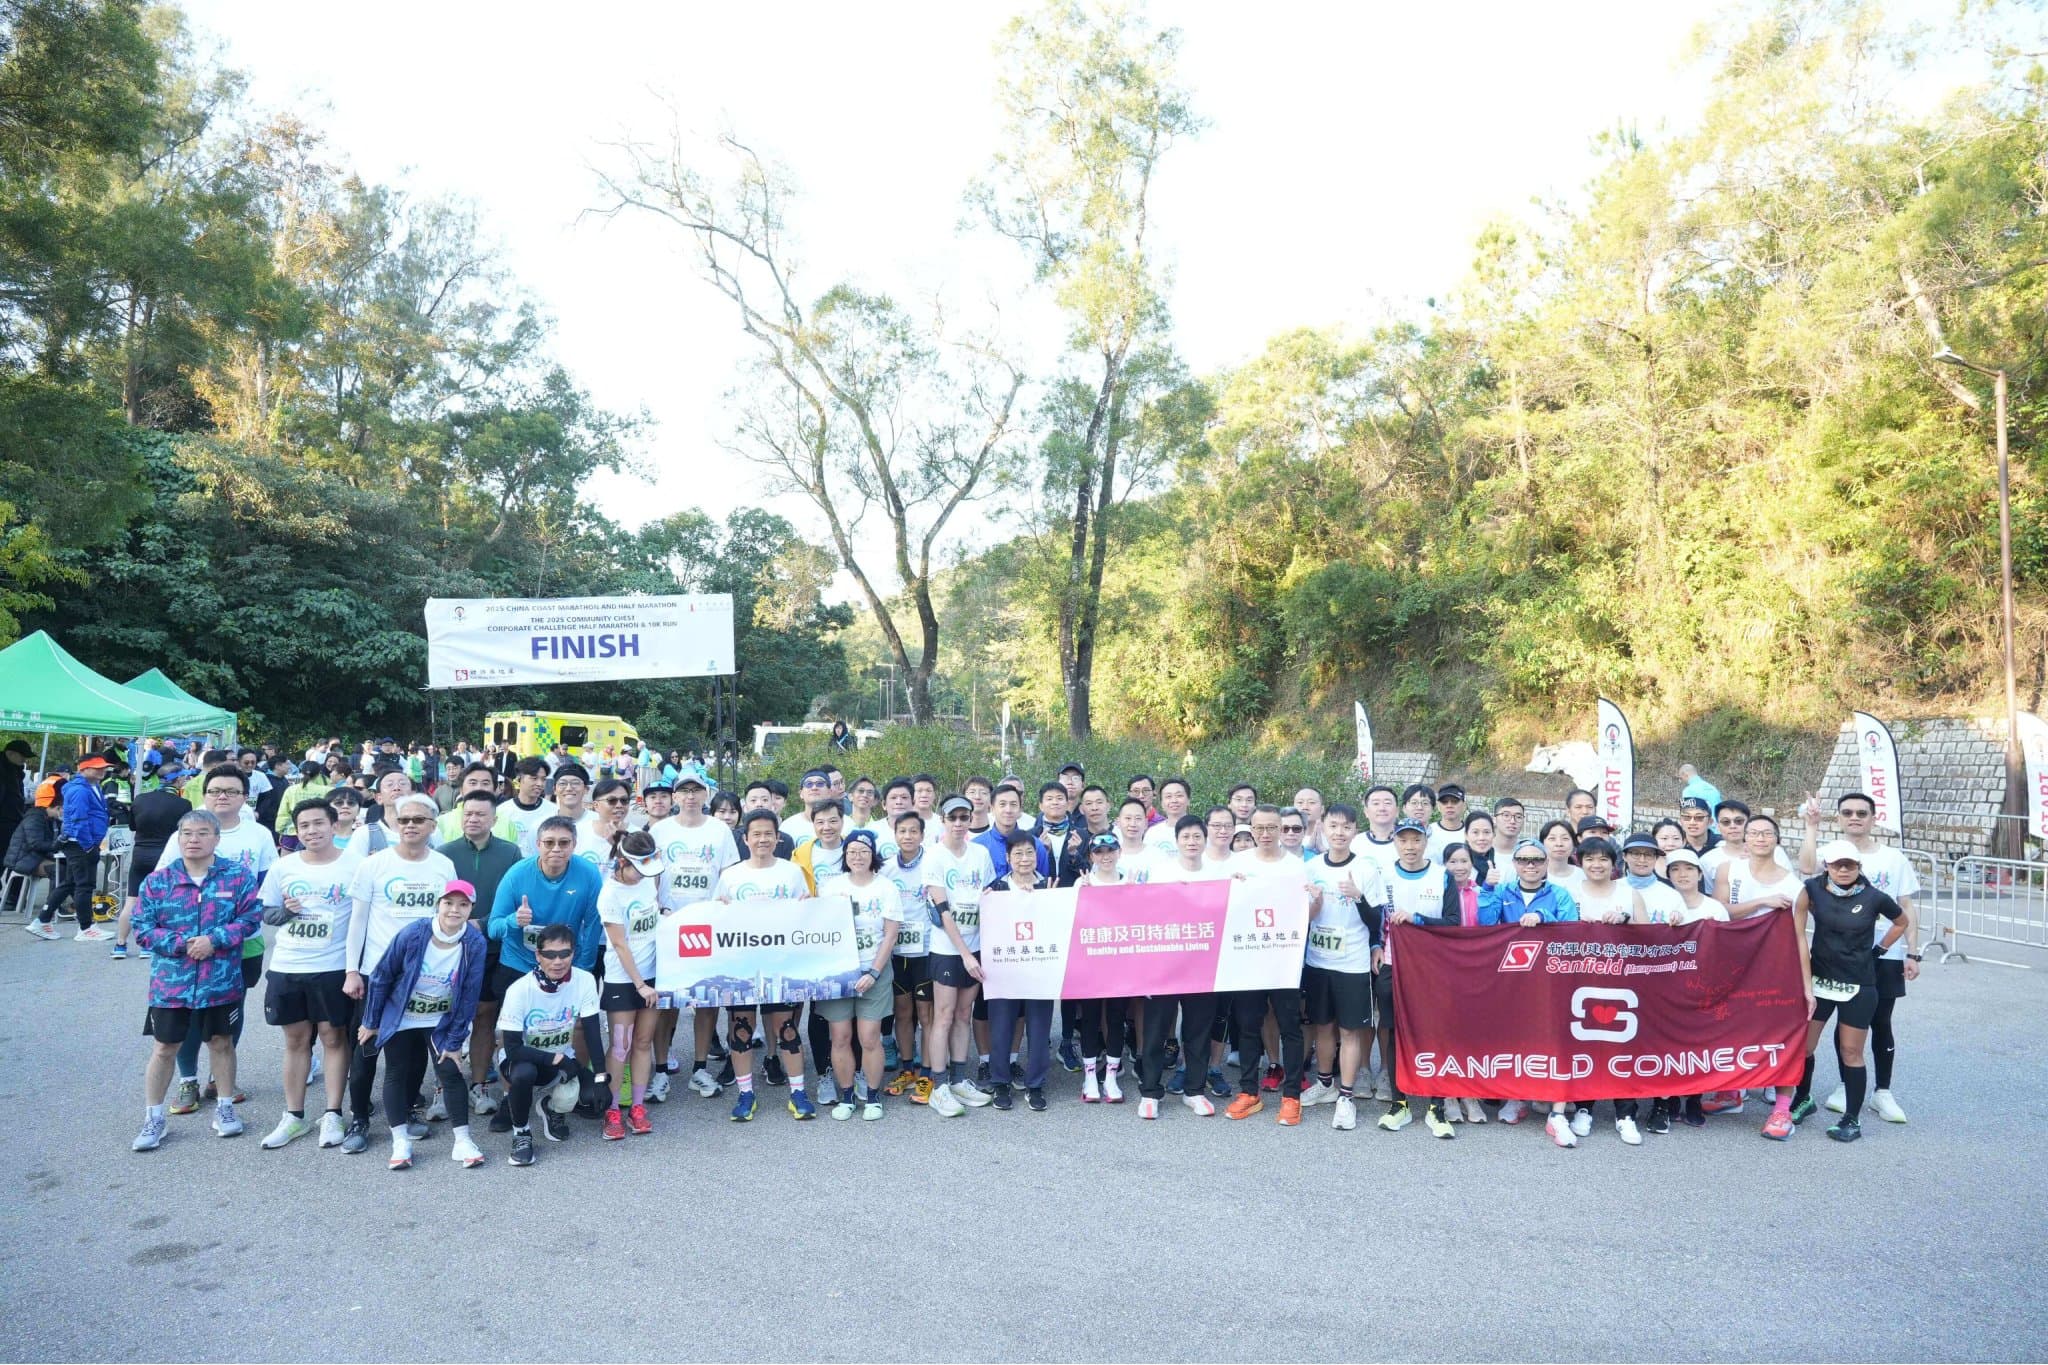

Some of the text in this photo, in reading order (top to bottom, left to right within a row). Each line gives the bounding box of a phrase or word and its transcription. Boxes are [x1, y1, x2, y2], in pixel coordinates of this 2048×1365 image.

[566, 615, 612, 623] COMMUNITY
[531, 634, 639, 660] FINISH
[674, 875, 708, 889] 4349
[396, 892, 435, 907] 4348
[288, 923, 328, 938] 4408
[896, 931, 920, 945] 038
[1080, 922, 1214, 944] 健康及可持續生活
[716, 930, 842, 948] Wilson Group
[1312, 933, 1342, 950] 4417
[1087, 942, 1210, 956] Healthy and Sustainable Living
[1546, 956, 1624, 975] Sanfield
[1679, 960, 1698, 971] Ltd.
[407, 999, 450, 1014] 4326
[530, 1032, 570, 1048] 4448
[1415, 1043, 1785, 1081] SANFIELD CONNECT
